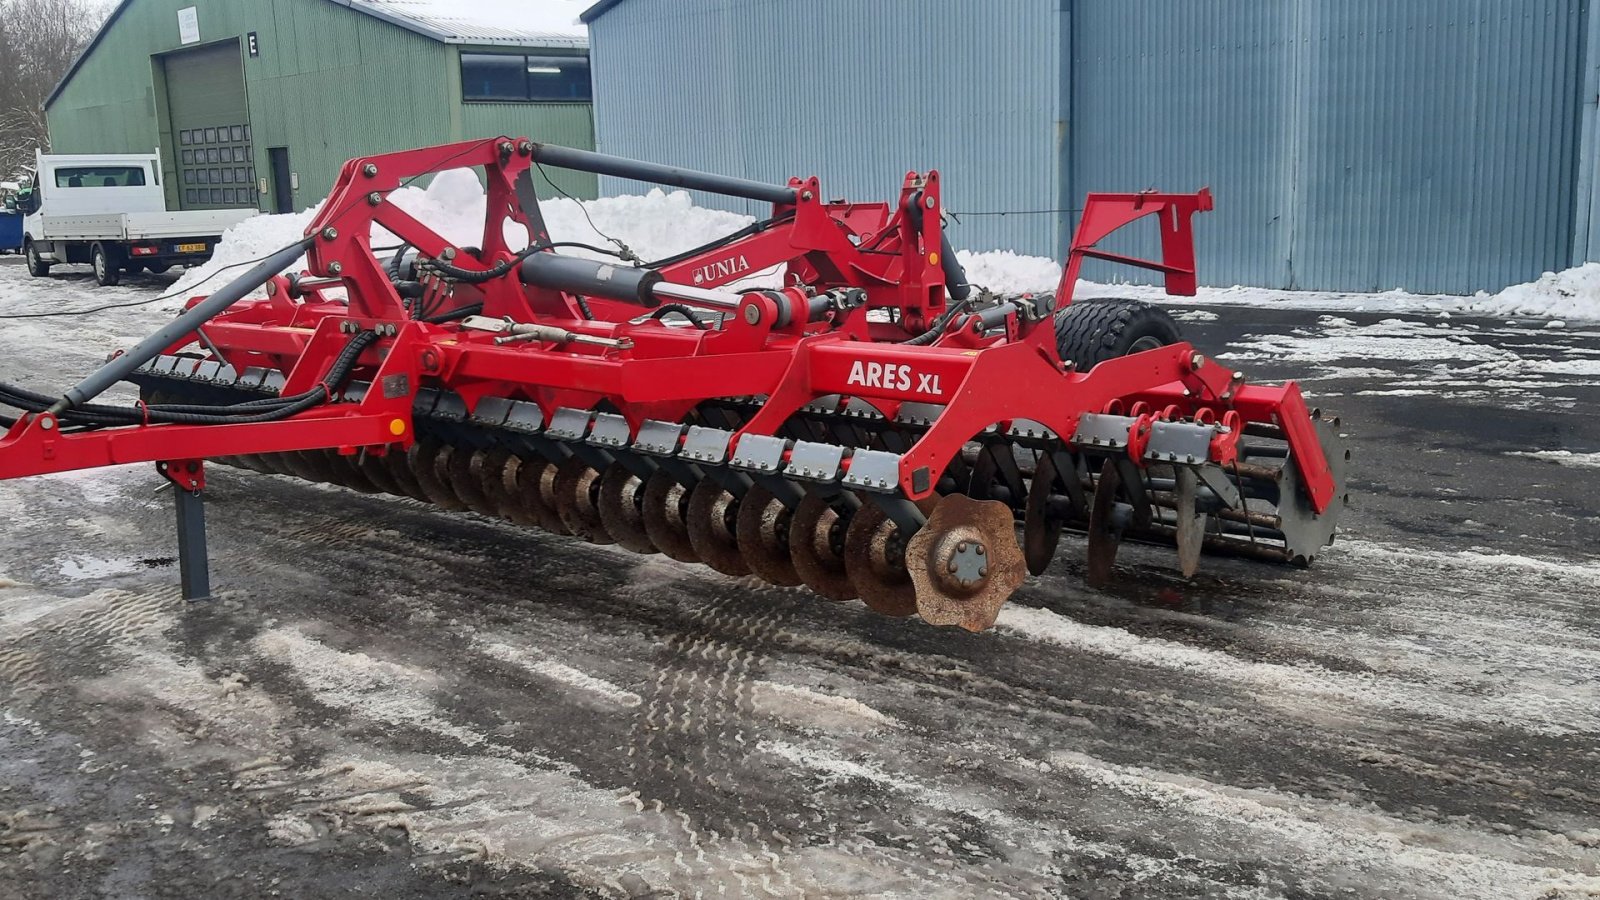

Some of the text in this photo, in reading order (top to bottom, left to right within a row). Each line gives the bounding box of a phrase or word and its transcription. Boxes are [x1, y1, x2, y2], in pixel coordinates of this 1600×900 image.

[249, 36, 256, 54] E
[703, 255, 750, 281] UNIA
[847, 360, 942, 395] ARES XL
